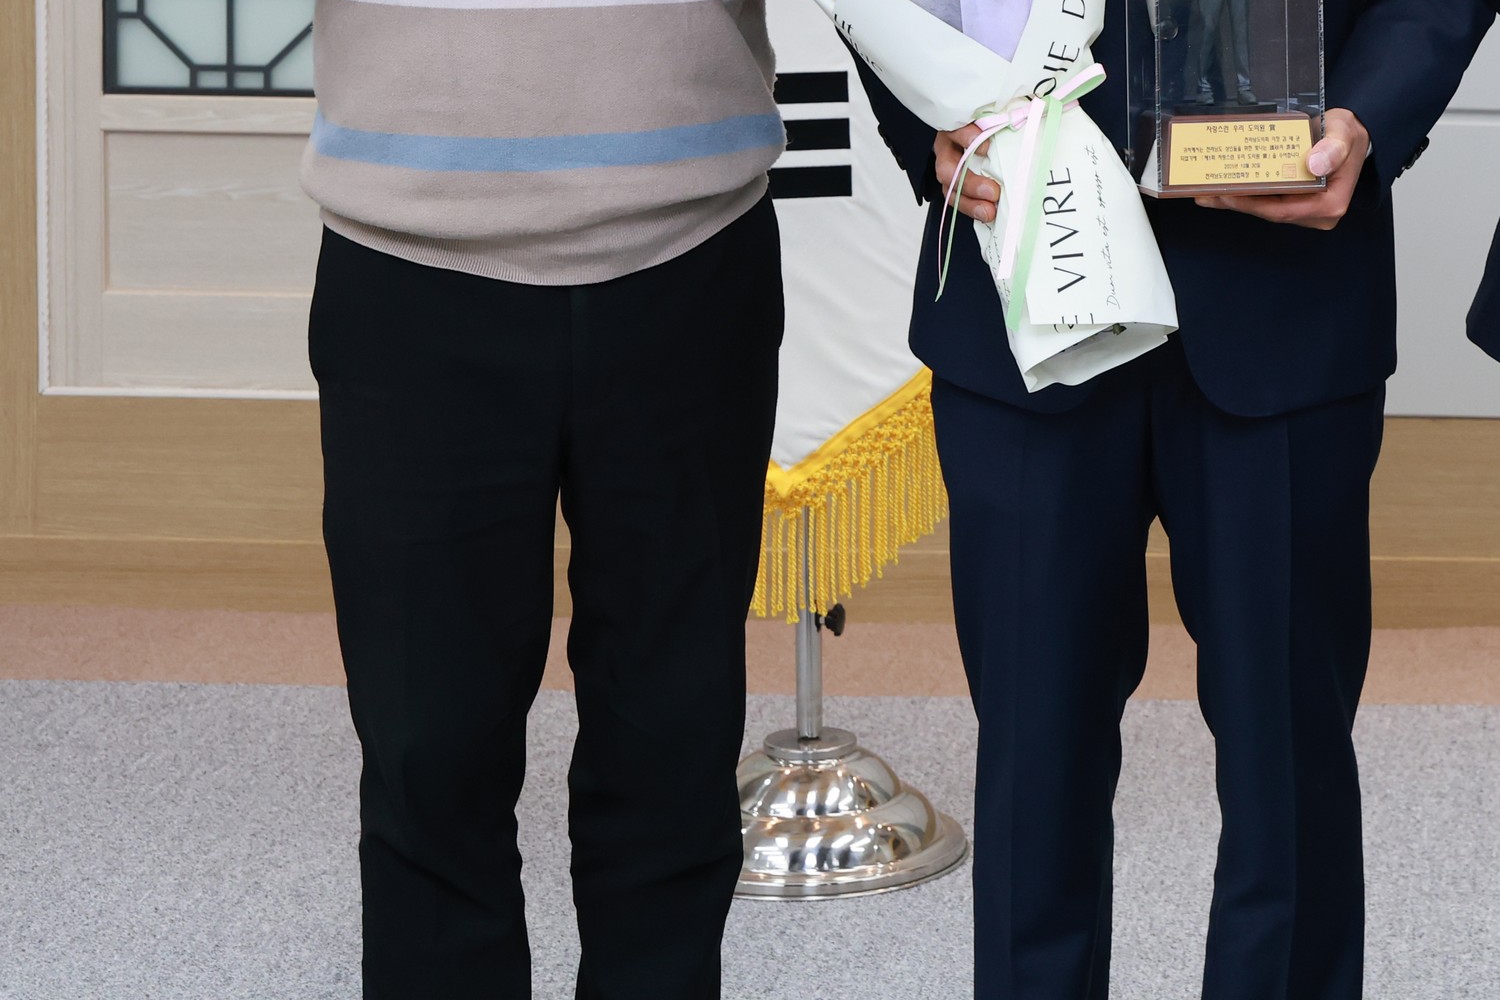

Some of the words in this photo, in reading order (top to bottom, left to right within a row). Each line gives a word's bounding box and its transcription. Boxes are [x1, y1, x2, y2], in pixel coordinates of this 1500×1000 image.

[1025, 41, 1080, 101] OIE
[1206, 125, 1229, 133] 자랑스런
[1233, 124, 1245, 132] 우리
[1248, 124, 1265, 132] 도의원
[1042, 167, 1087, 293] VIVRE
